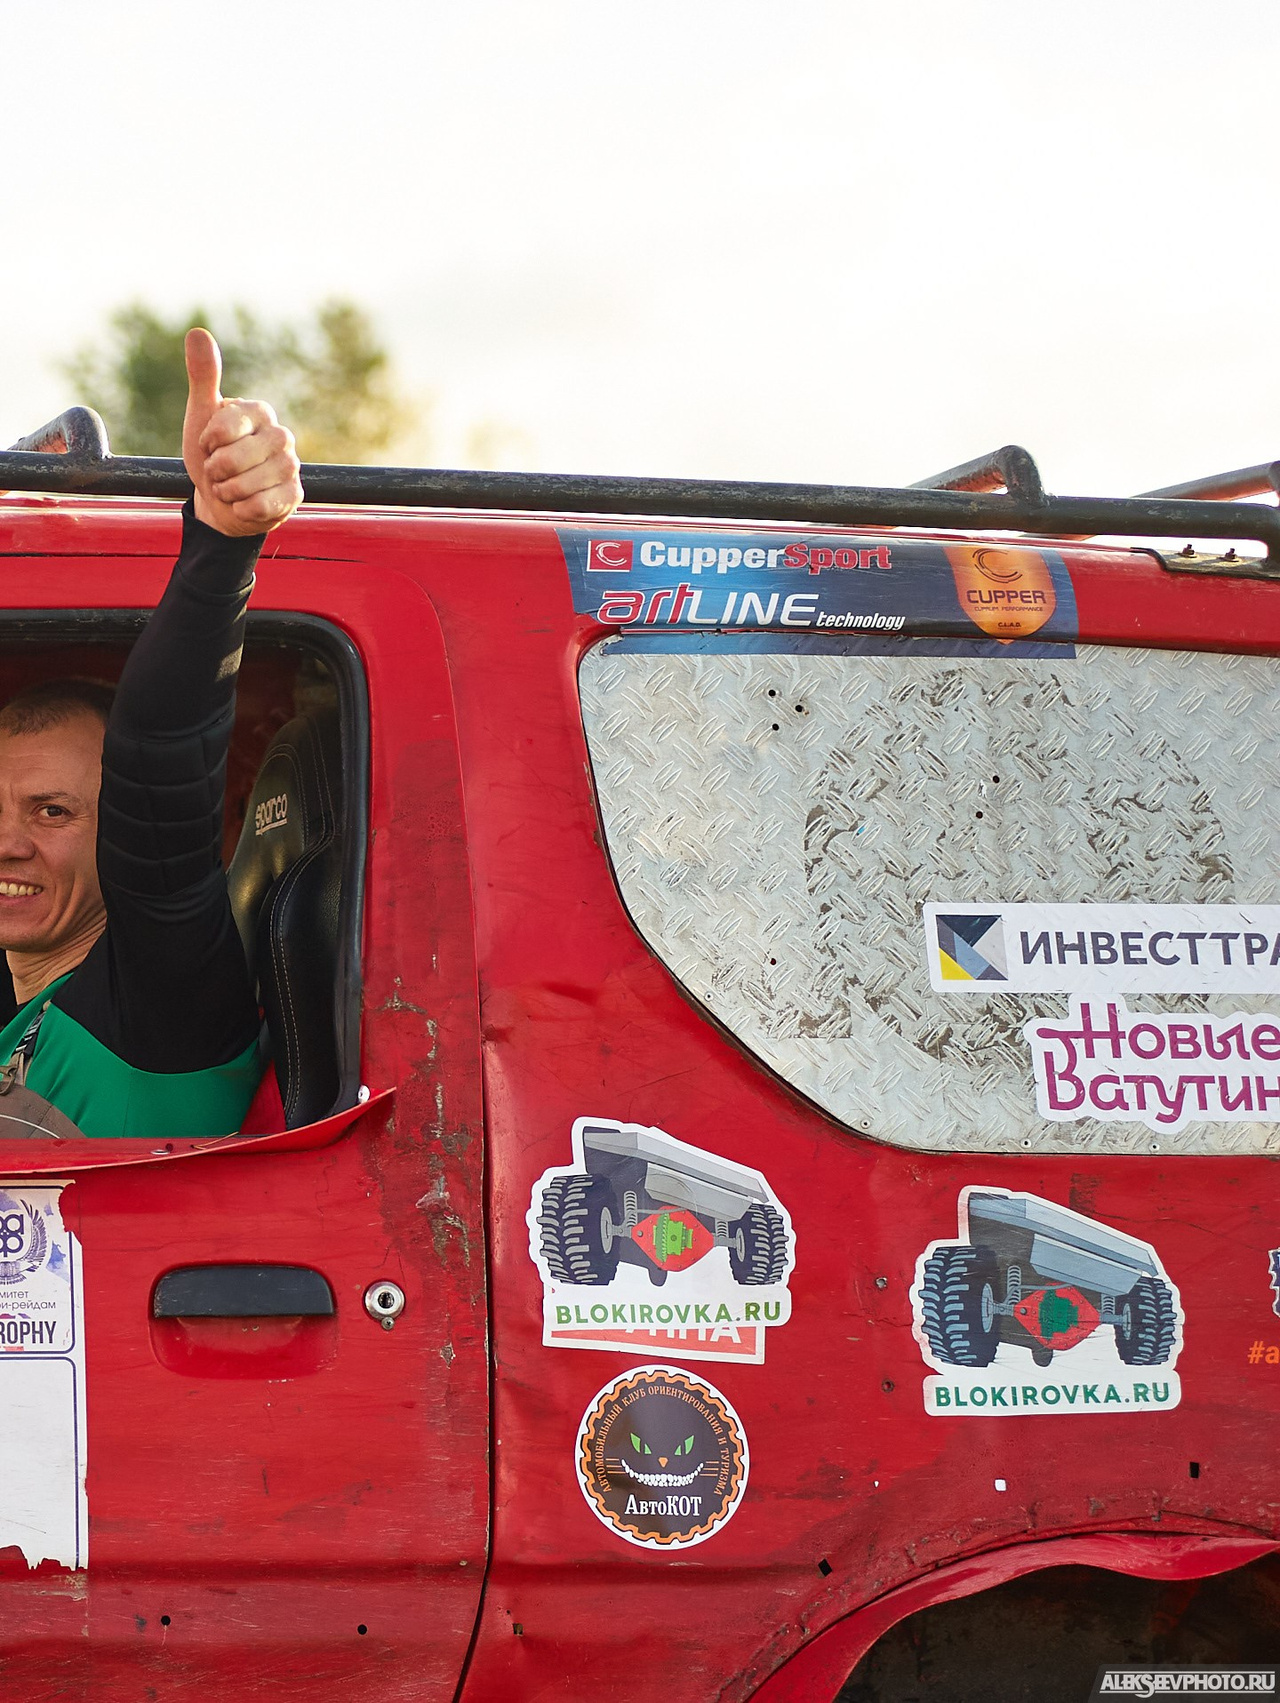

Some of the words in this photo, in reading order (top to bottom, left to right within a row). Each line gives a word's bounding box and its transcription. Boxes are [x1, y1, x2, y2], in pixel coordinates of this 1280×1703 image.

[640, 541, 892, 576] CupperSport
[597, 583, 820, 626] artLINE
[816, 611, 906, 632] technology
[966, 589, 1047, 604] CUPPER
[255, 793, 288, 829] sparco
[1036, 1002, 1280, 1061] Новые
[555, 1301, 781, 1325] BLOKIROVKA.RU
[622, 1387, 647, 1407] КЛУБ
[648, 1386, 723, 1435] ОРИЕНТИРОВАНИЯ
[934, 1382, 1170, 1407] BLOKIROVKA.RU
[594, 1405, 623, 1493] АВТОМОБИЛЬНЫЙ
[718, 1436, 727, 1445] И
[713, 1448, 730, 1495] ТУРИЗМА
